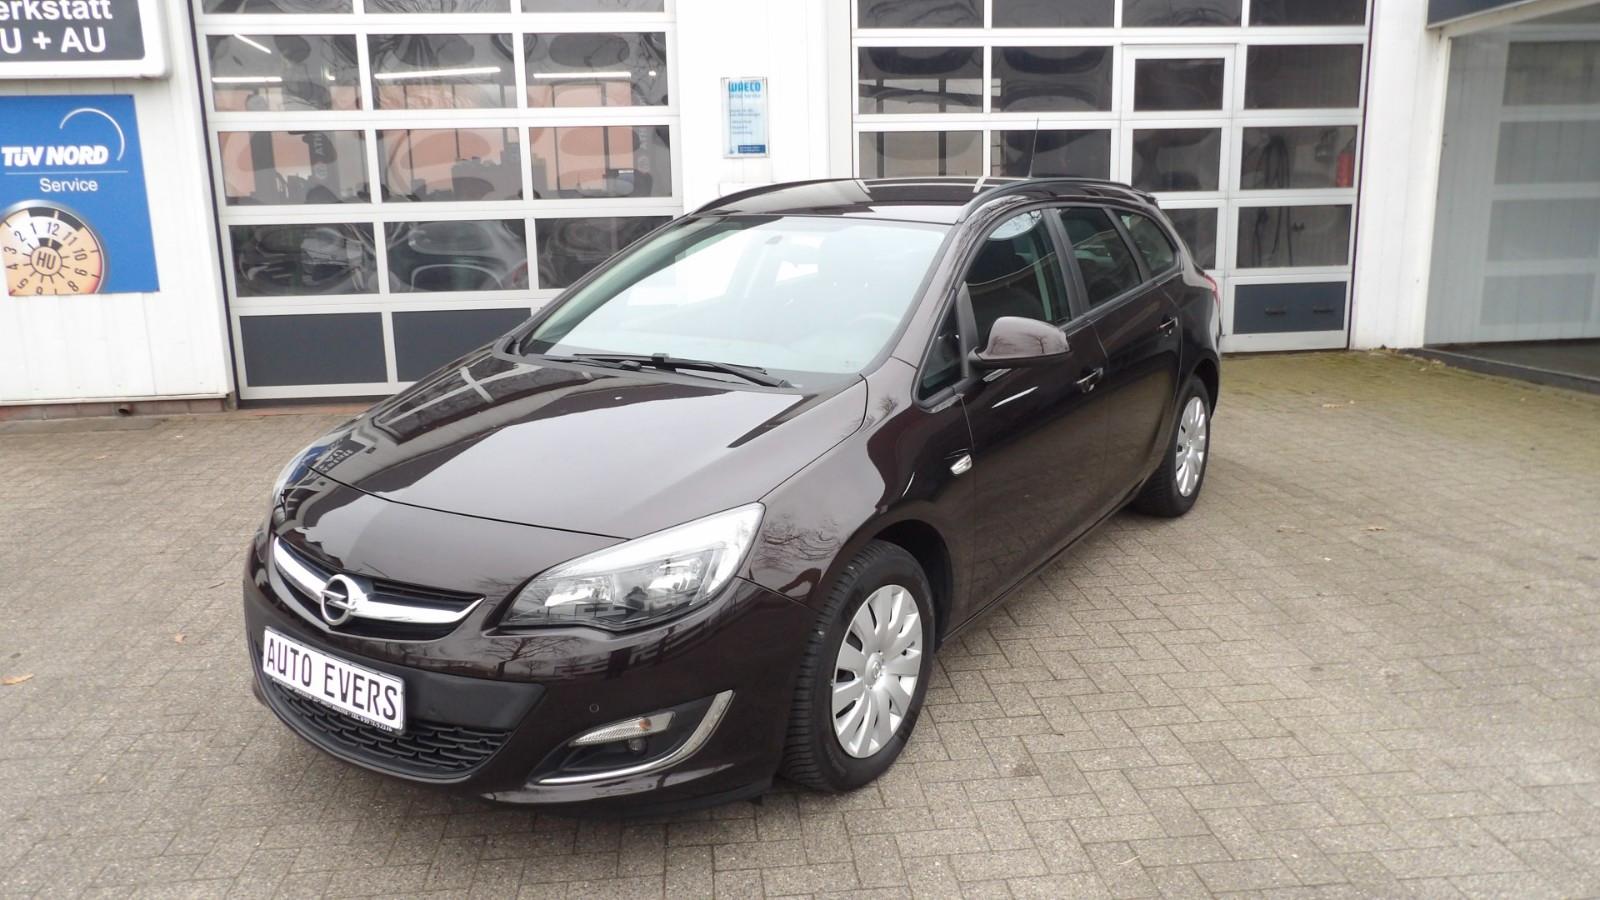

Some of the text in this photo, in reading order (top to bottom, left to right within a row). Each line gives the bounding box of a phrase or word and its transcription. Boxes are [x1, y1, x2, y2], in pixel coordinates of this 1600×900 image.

[32, 31, 51, 49] +
[61, 26, 106, 53] AU
[728, 80, 761, 92] WAECO
[1, 145, 109, 166] TÜV NORD
[39, 177, 98, 192] Service
[14, 230, 26, 242] 2
[47, 221, 60, 236] 12
[62, 231, 78, 246] 11
[36, 251, 56, 270] HU
[73, 248, 88, 261] 10
[267, 638, 398, 721] AUTO EVERS
